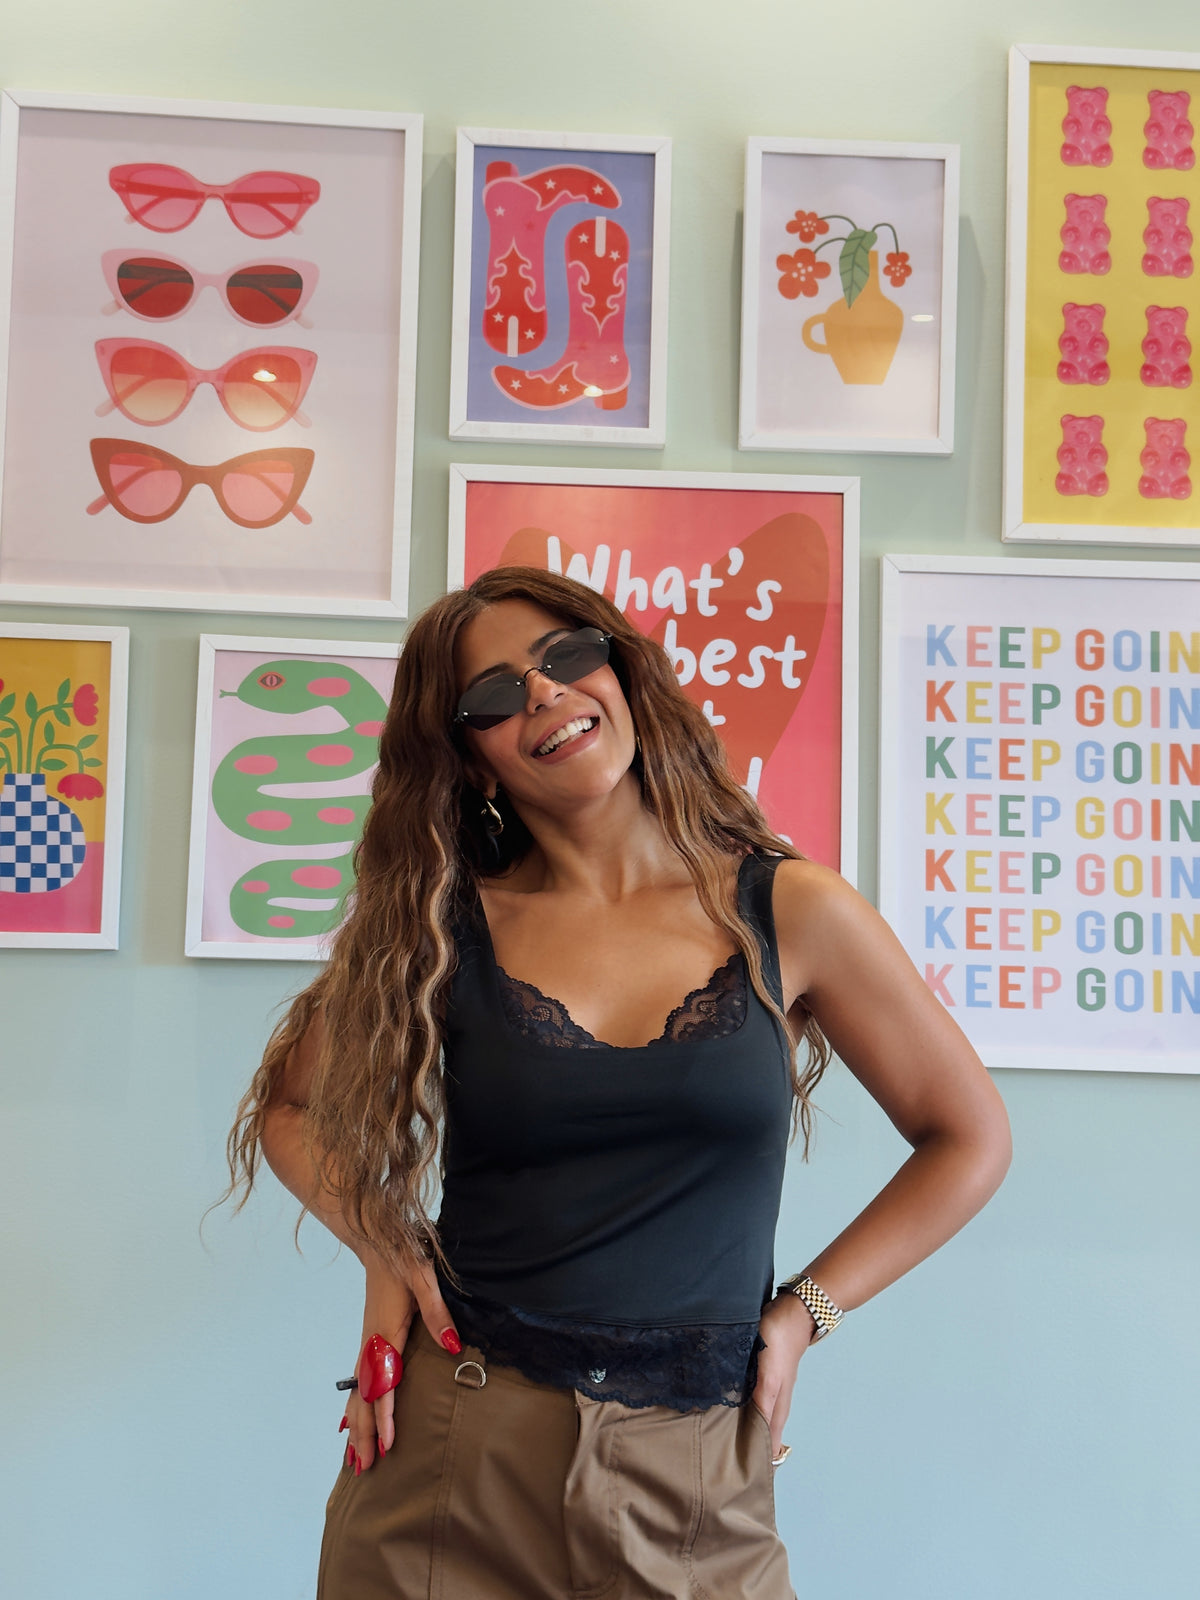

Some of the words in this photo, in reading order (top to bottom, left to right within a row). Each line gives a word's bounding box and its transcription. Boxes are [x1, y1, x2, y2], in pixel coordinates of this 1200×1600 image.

[547, 536, 782, 622] What's
[664, 619, 807, 689] best
[925, 624, 1062, 669] KEEP
[925, 680, 1062, 726] KEEP
[925, 736, 1062, 782] KEEP
[925, 792, 1062, 838] KEEP
[925, 849, 1062, 894] KEEP
[925, 906, 1062, 952] KEEP
[925, 963, 1062, 1010] KEEP
